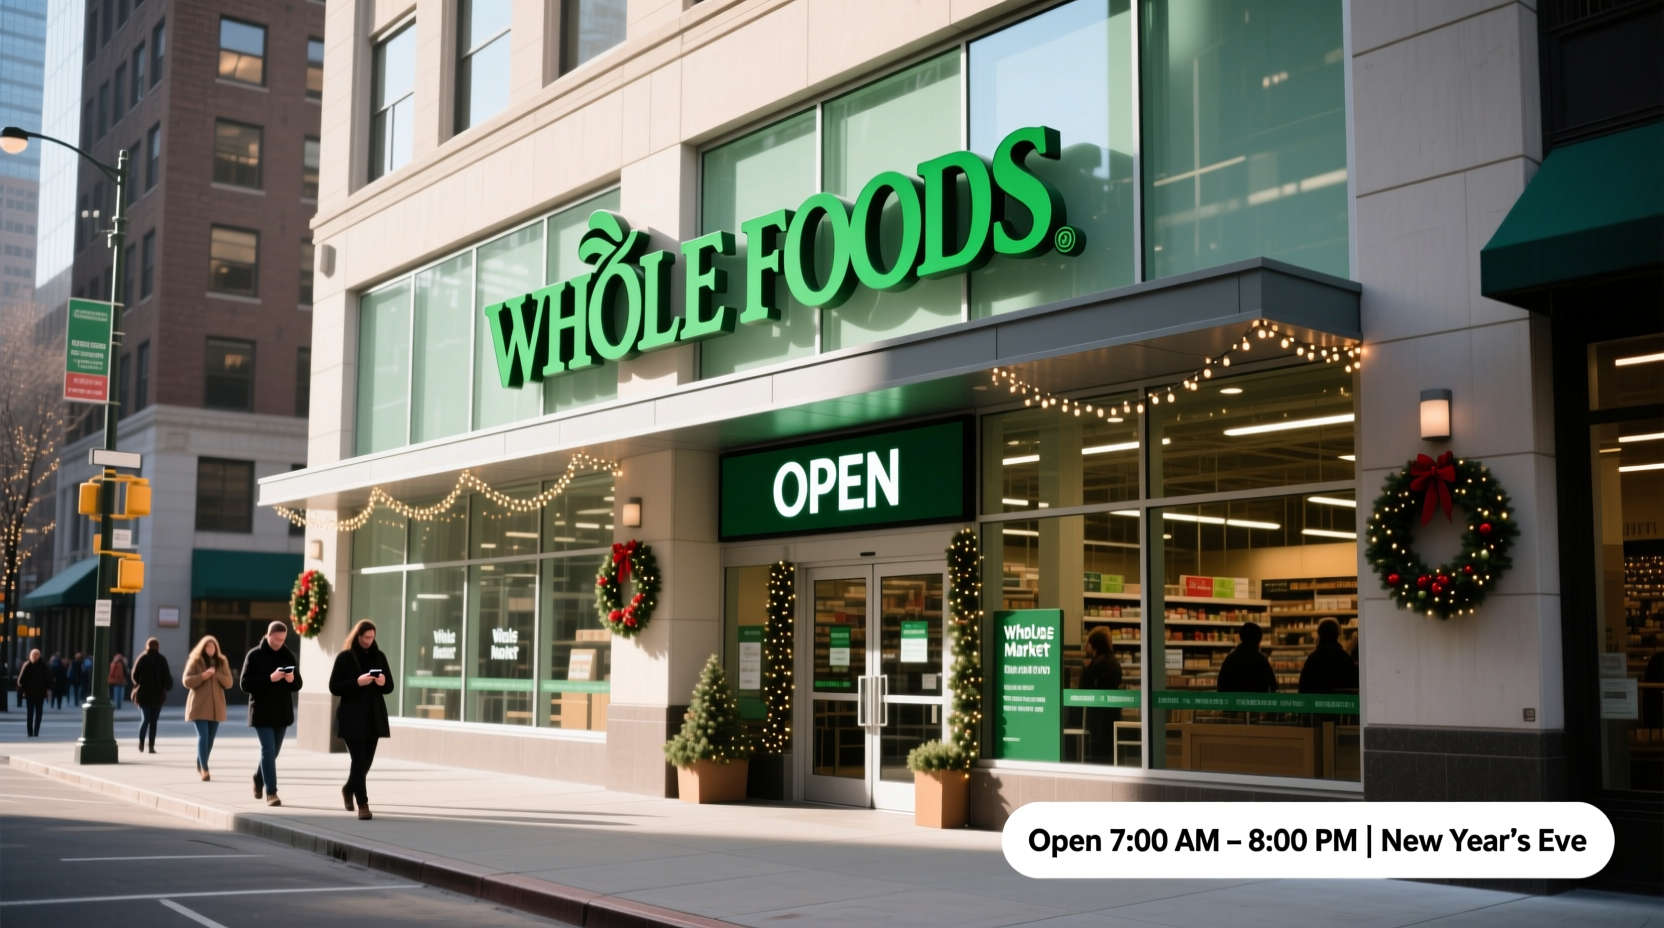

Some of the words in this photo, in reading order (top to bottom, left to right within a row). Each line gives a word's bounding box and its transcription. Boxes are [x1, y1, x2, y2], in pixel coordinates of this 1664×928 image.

[485, 210, 735, 388] WHOLE
[741, 126, 1062, 323] FOODS
[773, 448, 900, 518] OPEN
[1004, 641, 1051, 658] Market
